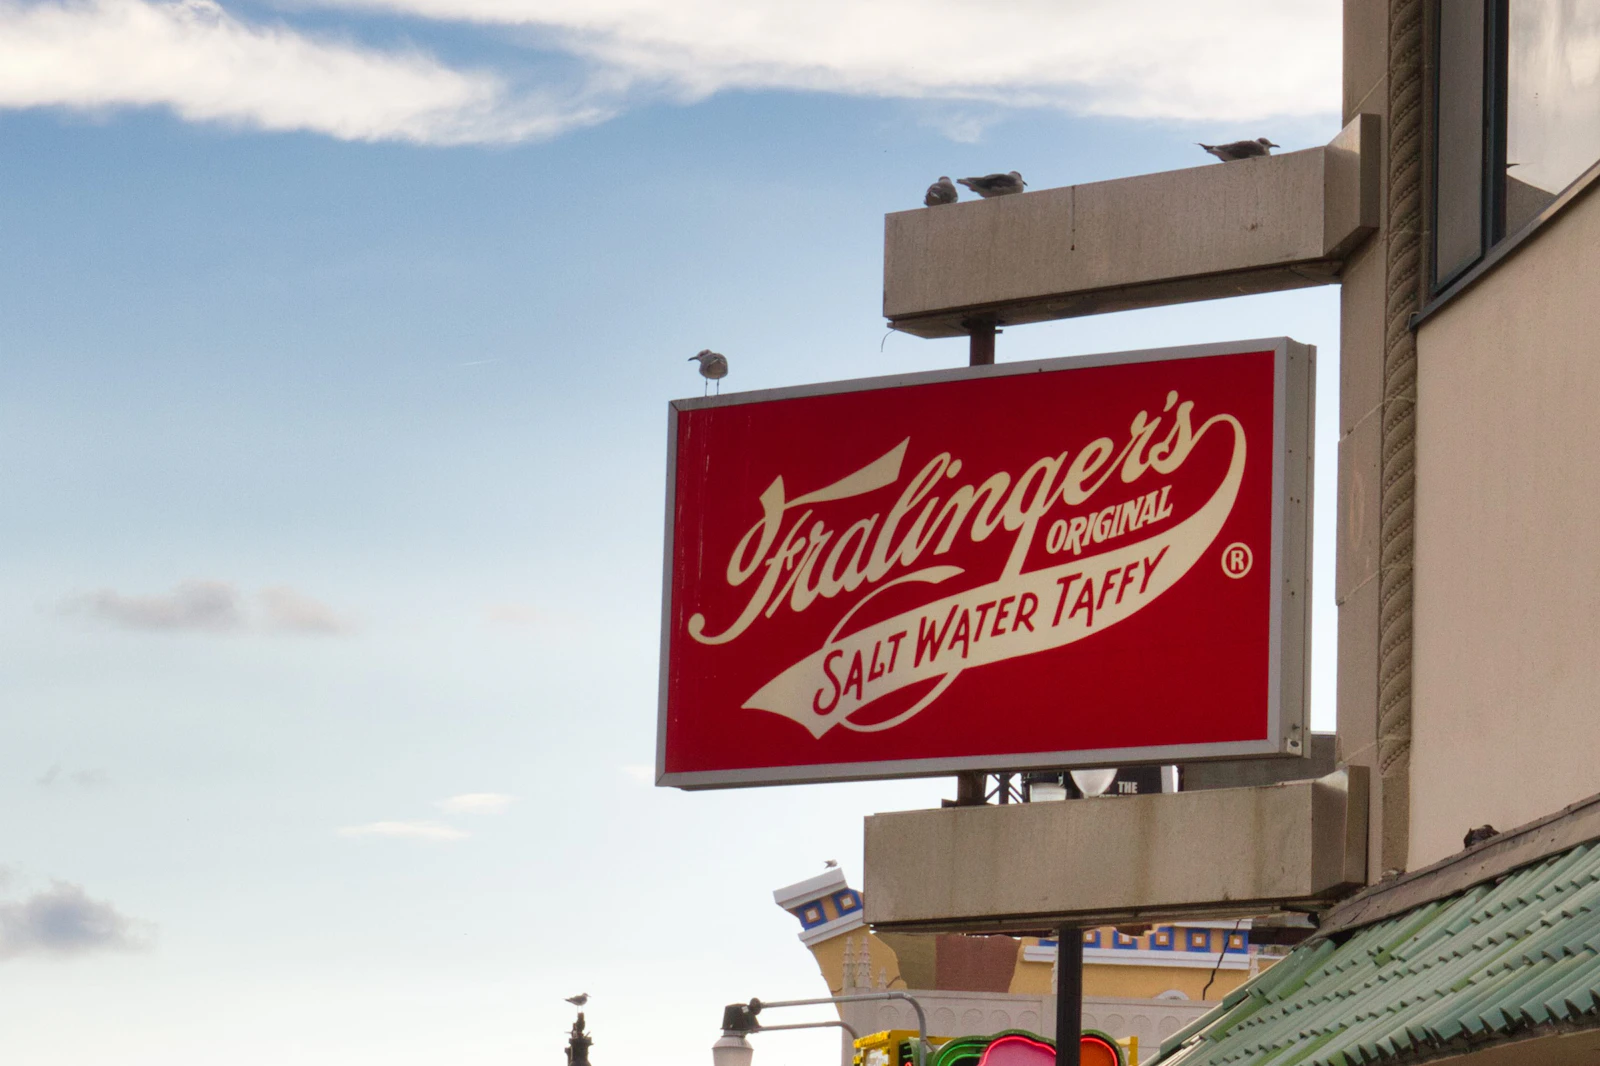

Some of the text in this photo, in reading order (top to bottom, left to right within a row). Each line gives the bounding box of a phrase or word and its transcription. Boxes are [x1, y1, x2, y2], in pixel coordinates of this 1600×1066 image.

[688, 389, 1202, 646] Fralinger's
[1045, 484, 1174, 556] ORIGINAL
[812, 544, 1171, 717] SALT WATER TAFFY
[1117, 781, 1138, 794] THE
